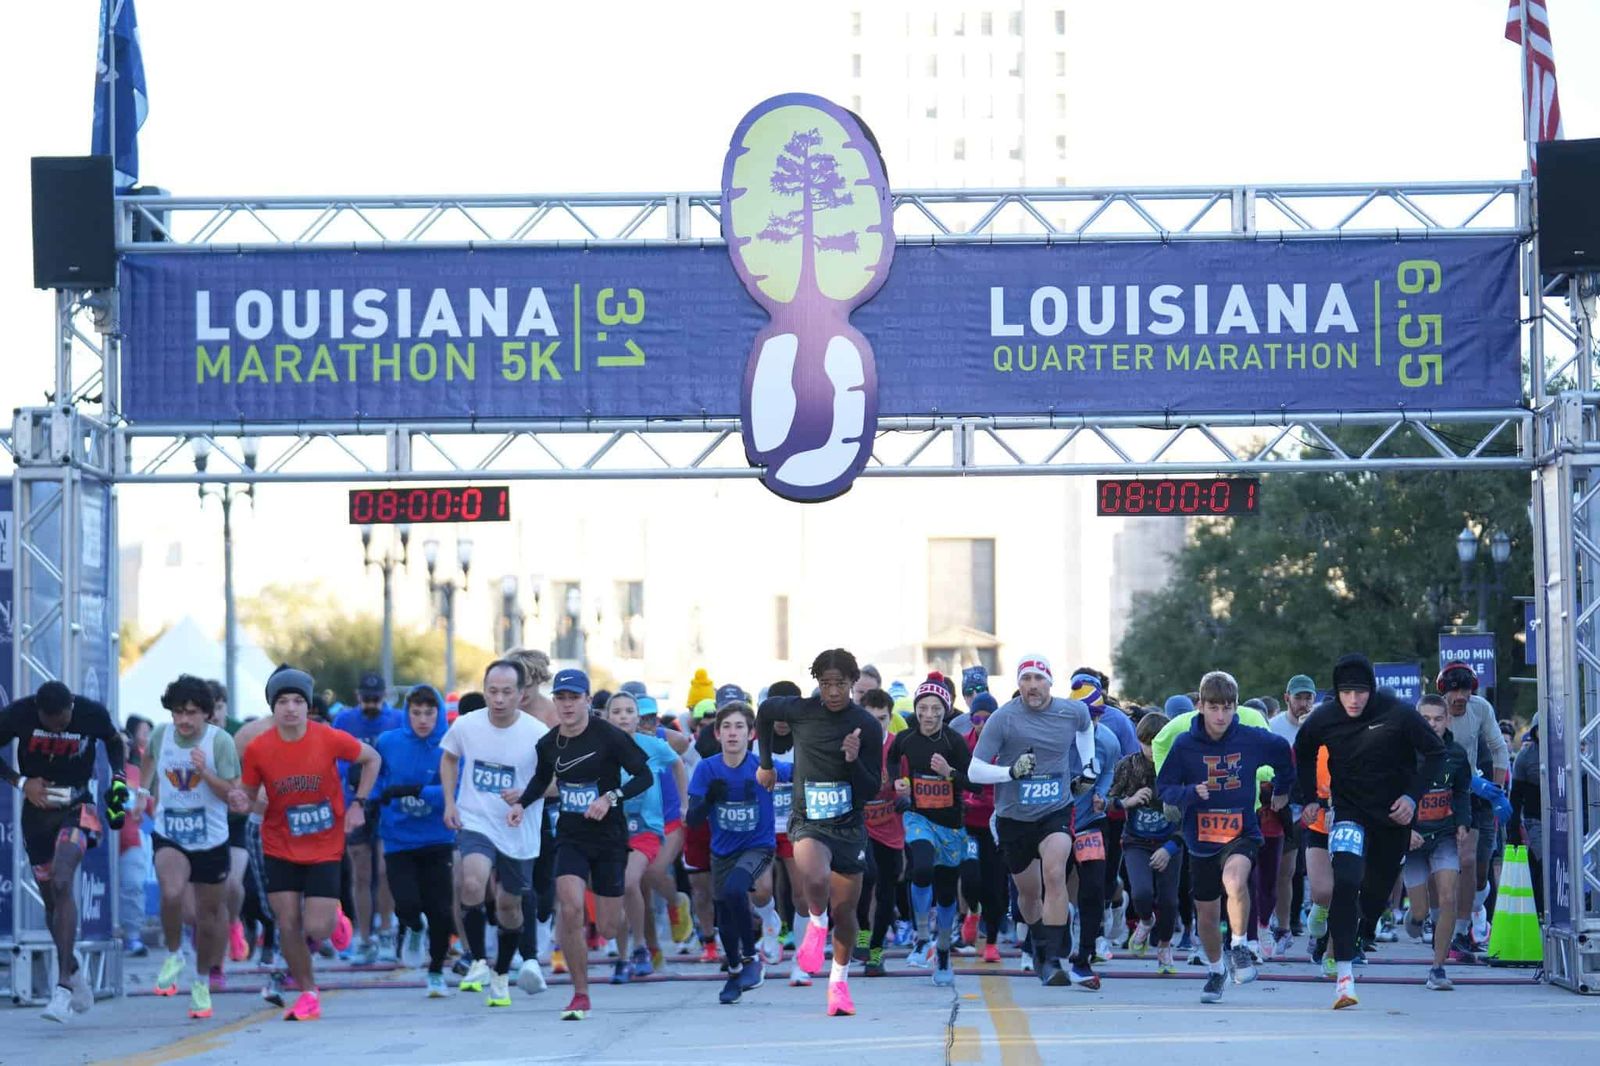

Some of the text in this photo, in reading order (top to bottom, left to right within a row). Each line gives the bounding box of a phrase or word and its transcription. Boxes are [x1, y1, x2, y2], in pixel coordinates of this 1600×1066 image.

[195, 287, 559, 341] LOUISIANA
[990, 283, 1359, 337] LOUISIANA
[596, 287, 645, 367] 3.1
[1397, 259, 1442, 388] 6.55
[195, 341, 563, 384] MARATHON 5K
[993, 343, 1358, 372] QUARTER MARATHON
[354, 488, 507, 522] 08:00:01
[1101, 482, 1255, 513] 08:00:01
[1441, 649, 1494, 660] 10:00 MIN
[1375, 676, 1400, 687] 11:00
[474, 769, 512, 788] 7316
[808, 789, 848, 806] 7901
[915, 783, 950, 797] 6008
[1022, 782, 1060, 798] 7283
[289, 806, 330, 826] 7018
[718, 806, 755, 821] 7051
[1201, 816, 1239, 830] 6174
[166, 815, 204, 832] 7034
